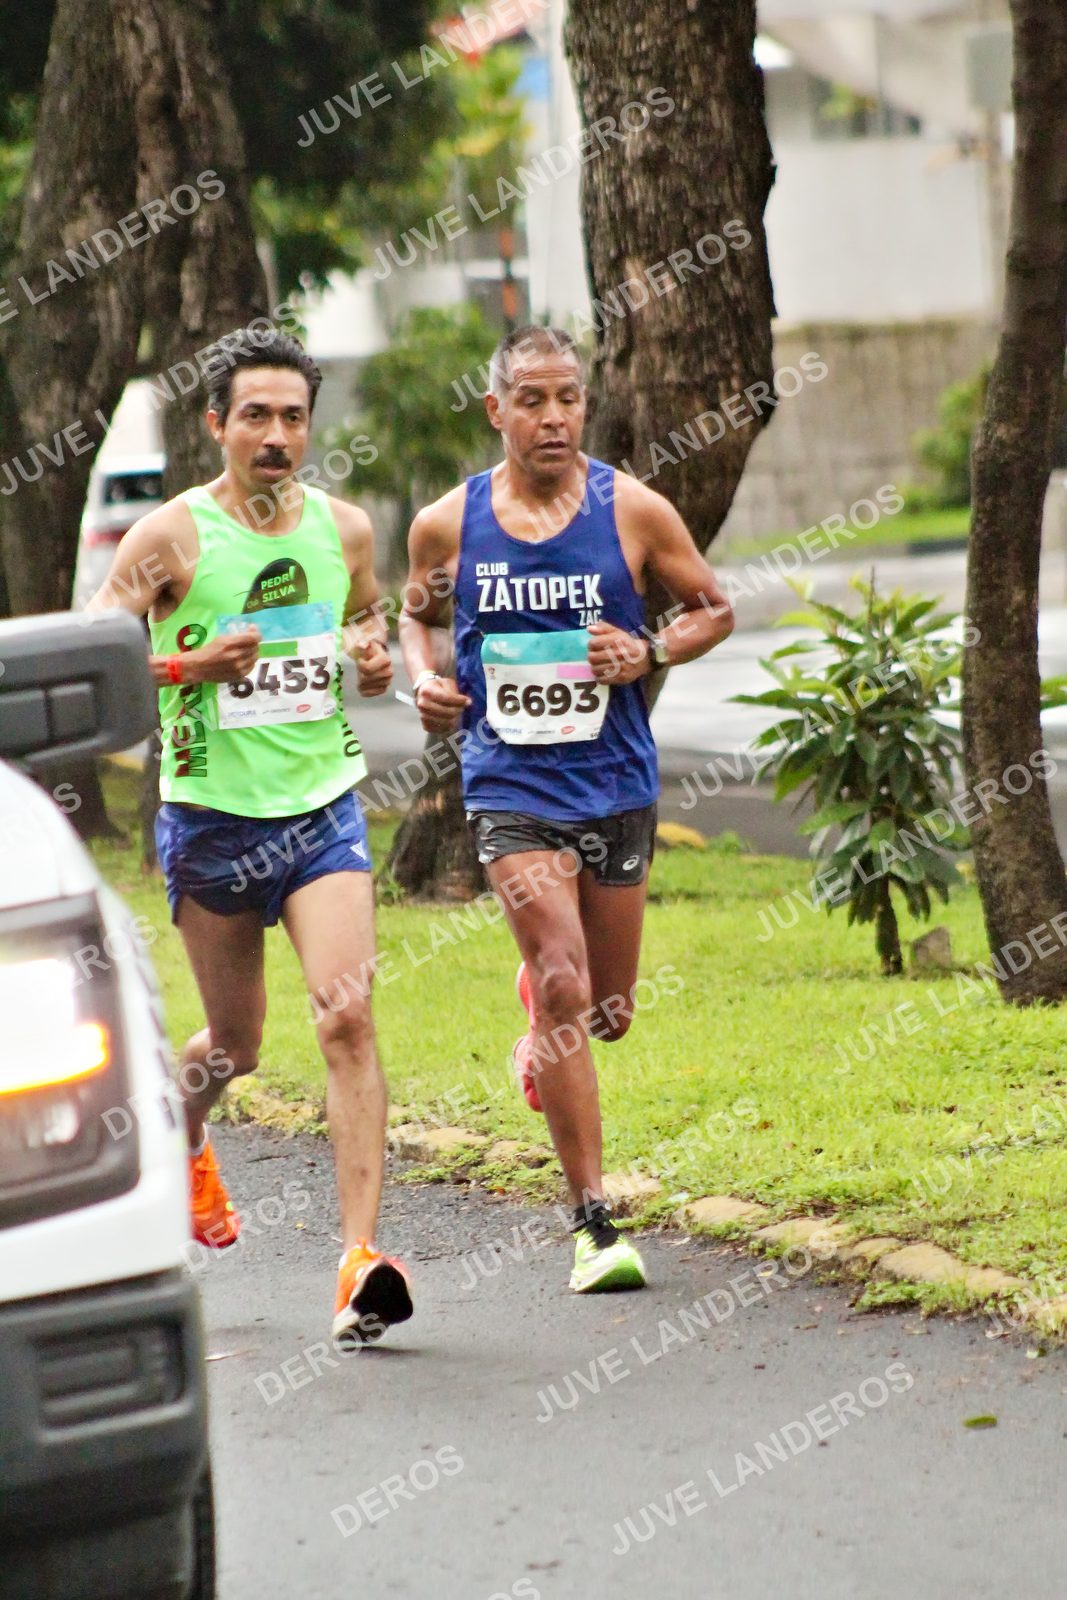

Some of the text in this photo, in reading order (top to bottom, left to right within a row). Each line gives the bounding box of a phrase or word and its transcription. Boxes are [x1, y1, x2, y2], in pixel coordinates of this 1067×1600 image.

[476, 562, 509, 577] CLUB
[262, 584, 296, 603] SILVA
[476, 574, 604, 613] ZATOPEK
[578, 609, 602, 626] ZAC
[228, 655, 331, 695] 6453
[172, 622, 208, 778] MEXIO
[497, 681, 601, 719] 6693
